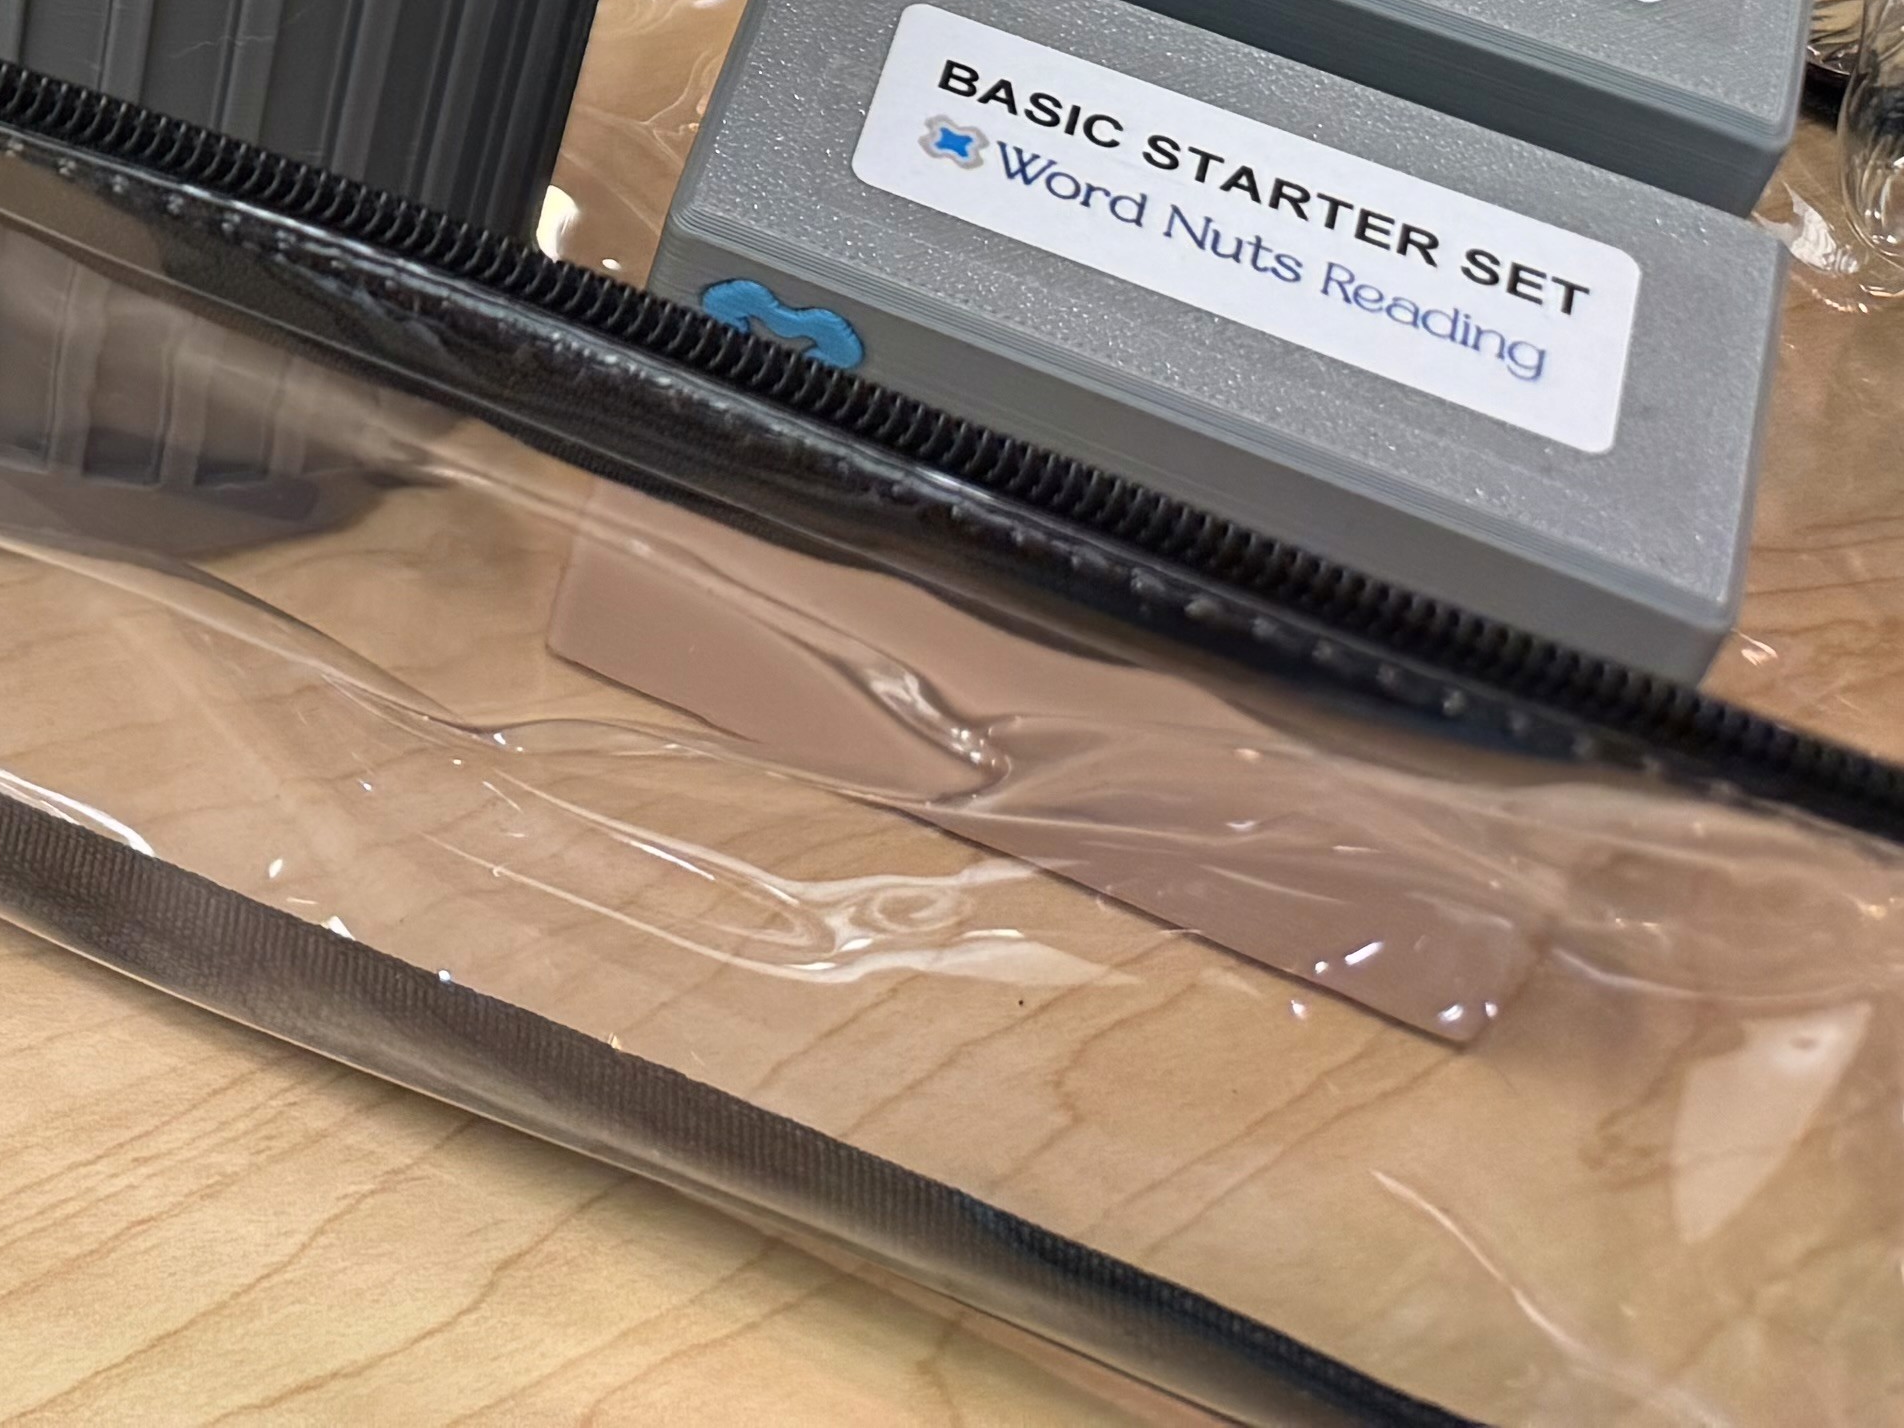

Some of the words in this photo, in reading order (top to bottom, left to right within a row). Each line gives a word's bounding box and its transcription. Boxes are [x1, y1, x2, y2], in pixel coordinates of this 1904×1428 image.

[937, 58, 1127, 149] BASIC
[1141, 132, 1443, 268] STARTER
[1459, 247, 1592, 318] SET
[995, 139, 1150, 229] Word
[1162, 205, 1305, 285] Nuts
[1319, 260, 1551, 383] Reading
